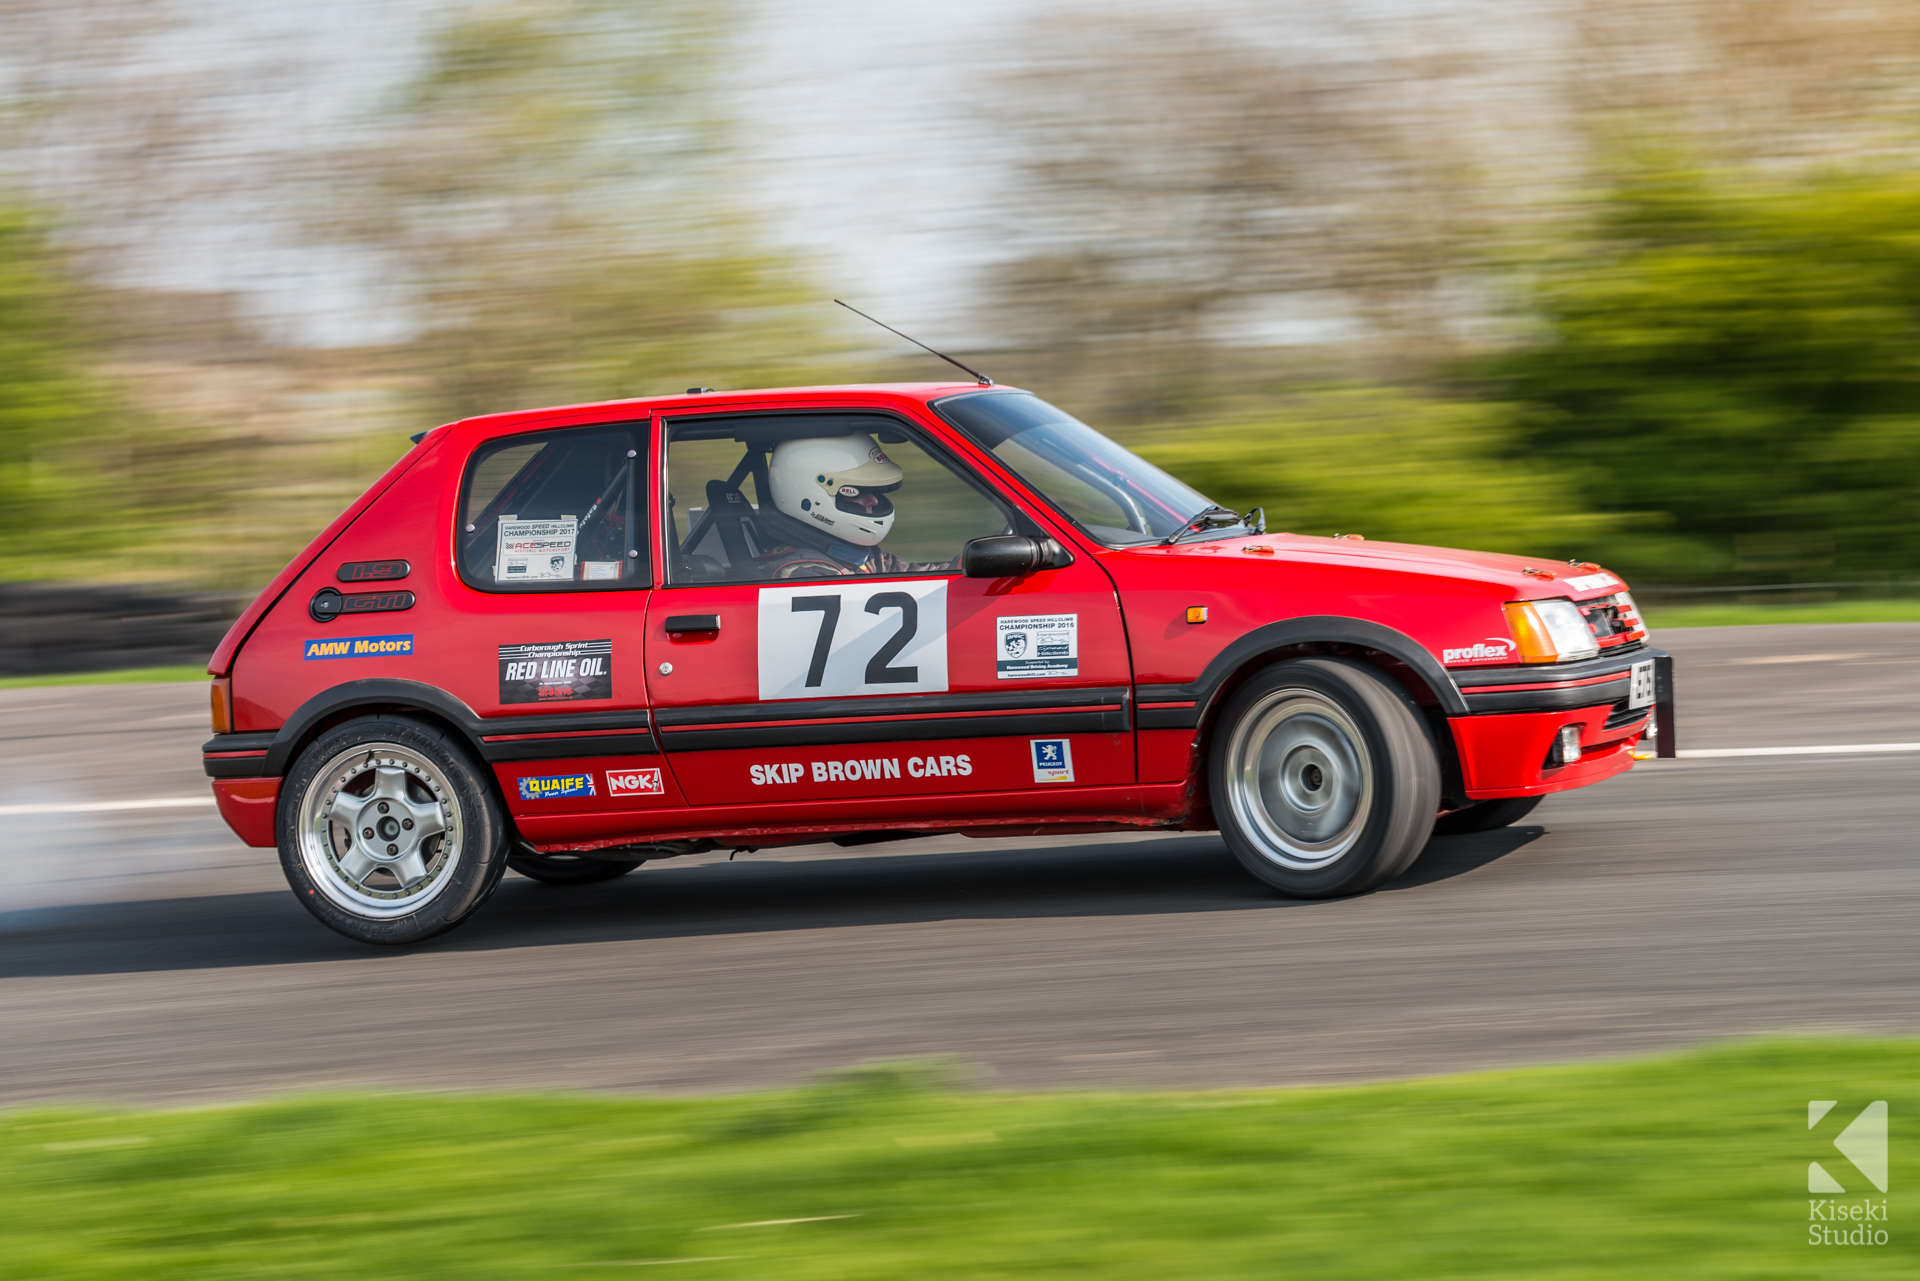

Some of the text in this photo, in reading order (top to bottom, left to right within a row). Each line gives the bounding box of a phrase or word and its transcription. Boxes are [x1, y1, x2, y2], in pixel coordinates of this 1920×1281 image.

[504, 529, 557, 537] CHAMPIONSHIP
[352, 563, 402, 579] 1.9
[344, 594, 407, 611] GTI
[565, 642, 588, 650] Sprint
[791, 592, 918, 687] 72
[307, 640, 411, 656] AMW Motors
[528, 650, 581, 658] Championship
[1442, 643, 1508, 664] proflex
[505, 657, 608, 681] RED LINE OIL.
[750, 754, 973, 785] SKIP BROWN CARS
[1047, 769, 1070, 777] sport
[529, 777, 584, 793] QUAIFE
[610, 774, 653, 791] NGK
